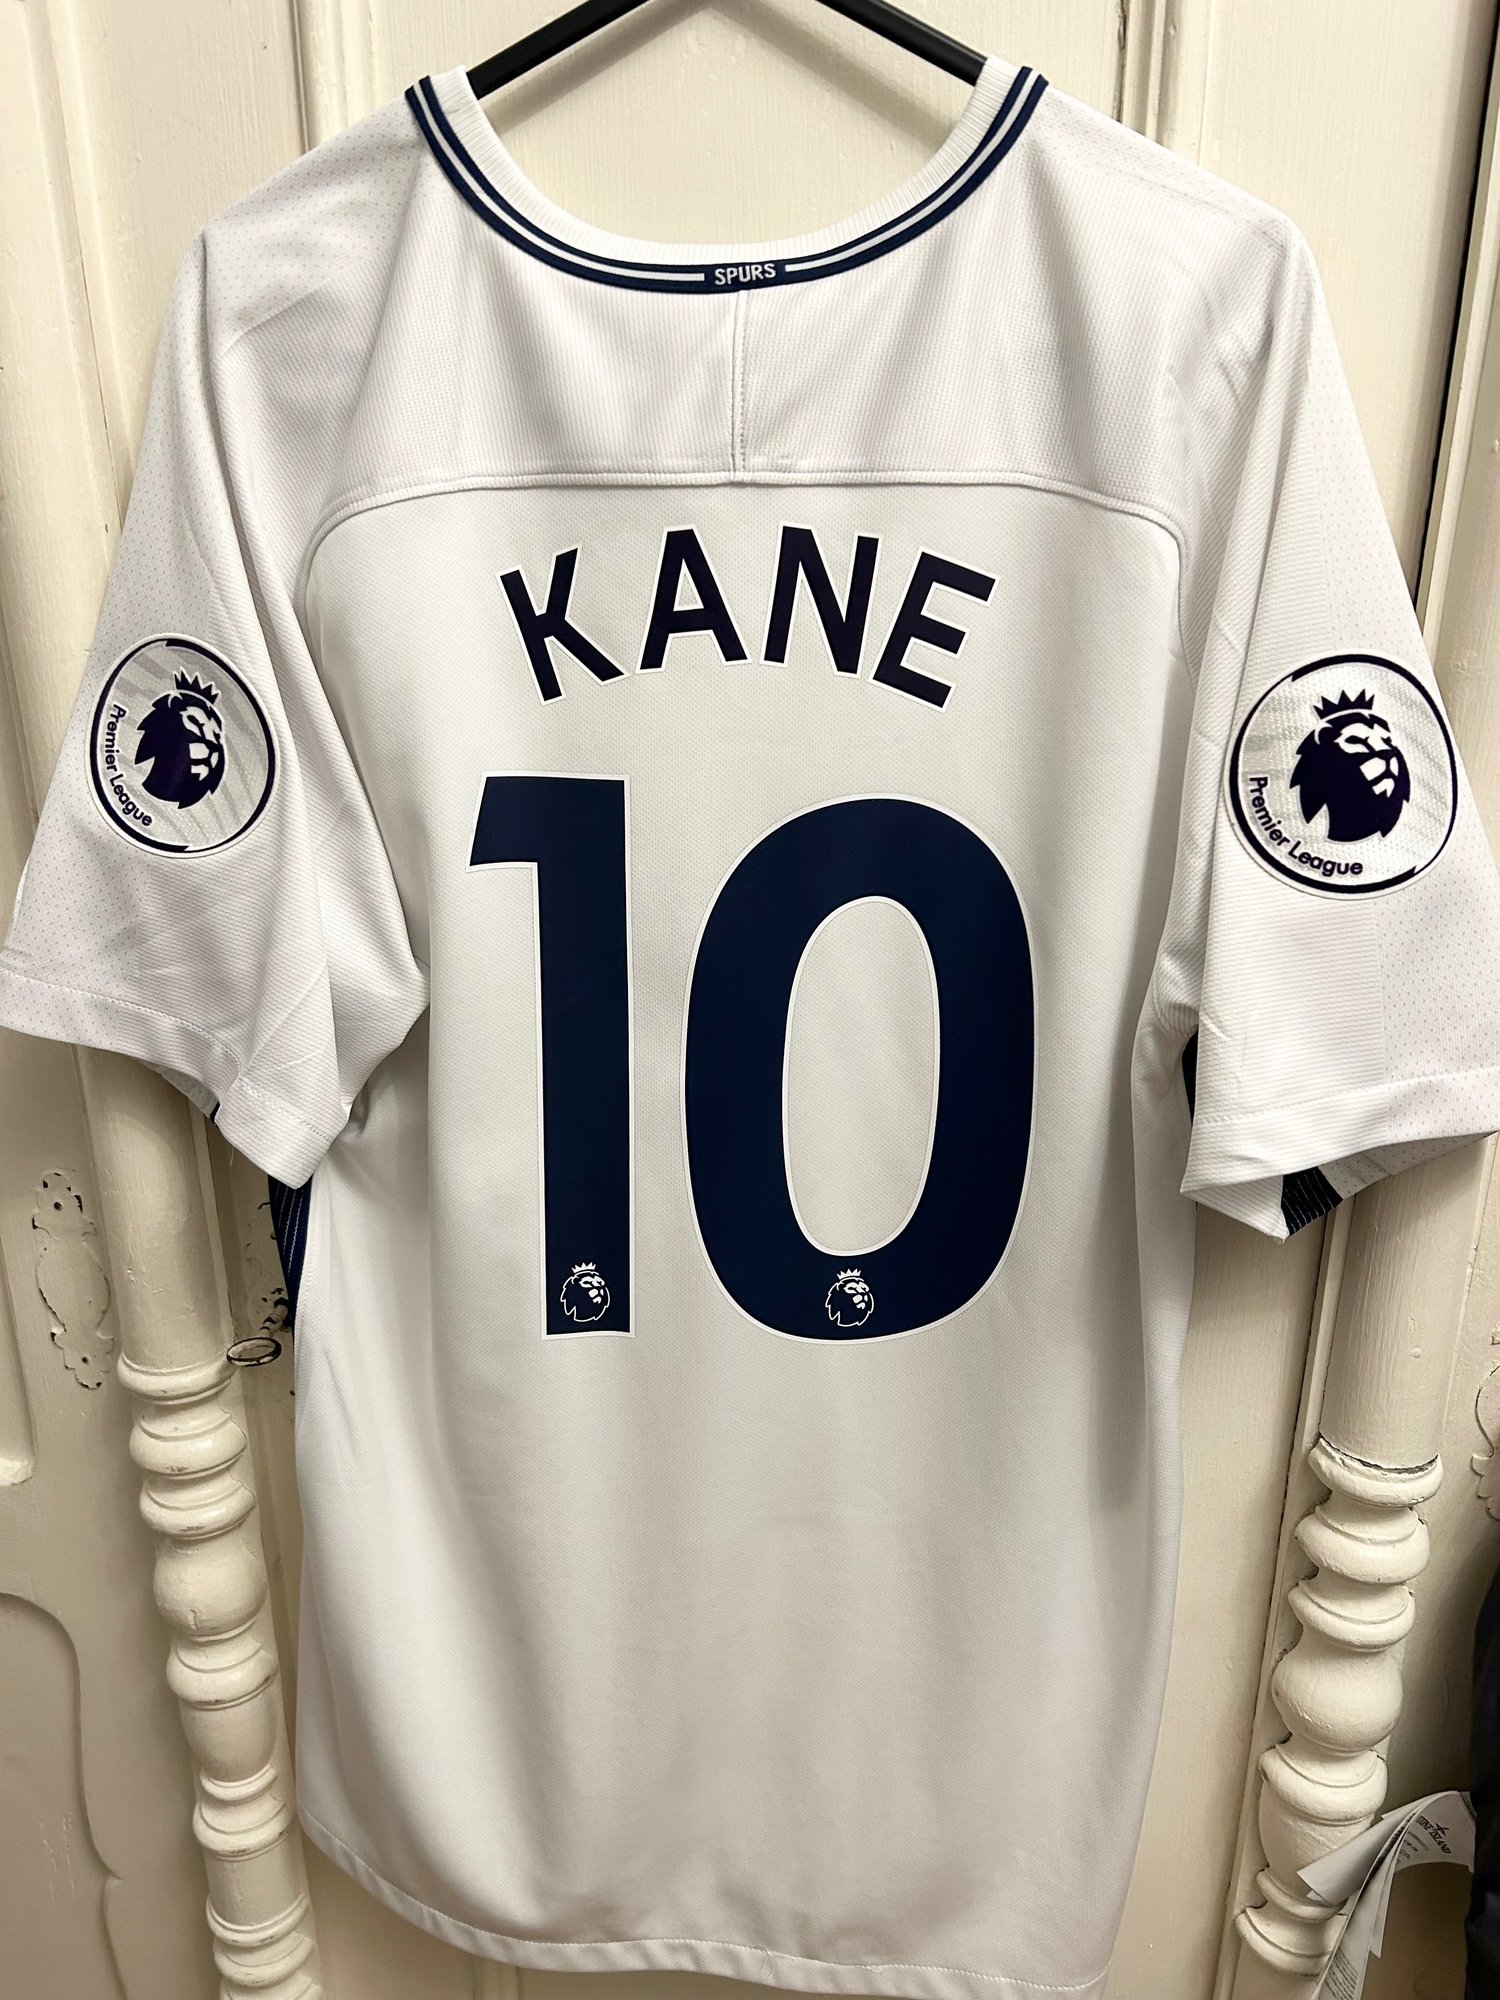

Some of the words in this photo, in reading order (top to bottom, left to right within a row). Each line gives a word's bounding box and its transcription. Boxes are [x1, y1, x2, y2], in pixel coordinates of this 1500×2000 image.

[715, 263, 776, 285] SPURS
[500, 525, 996, 709] KANE
[105, 703, 127, 772] Premier
[109, 773, 153, 827] League
[1249, 776, 1291, 847] Premier
[1288, 840, 1363, 877] League
[469, 775, 1034, 1341] 10
[1429, 1828, 1452, 1854] ISLAND
